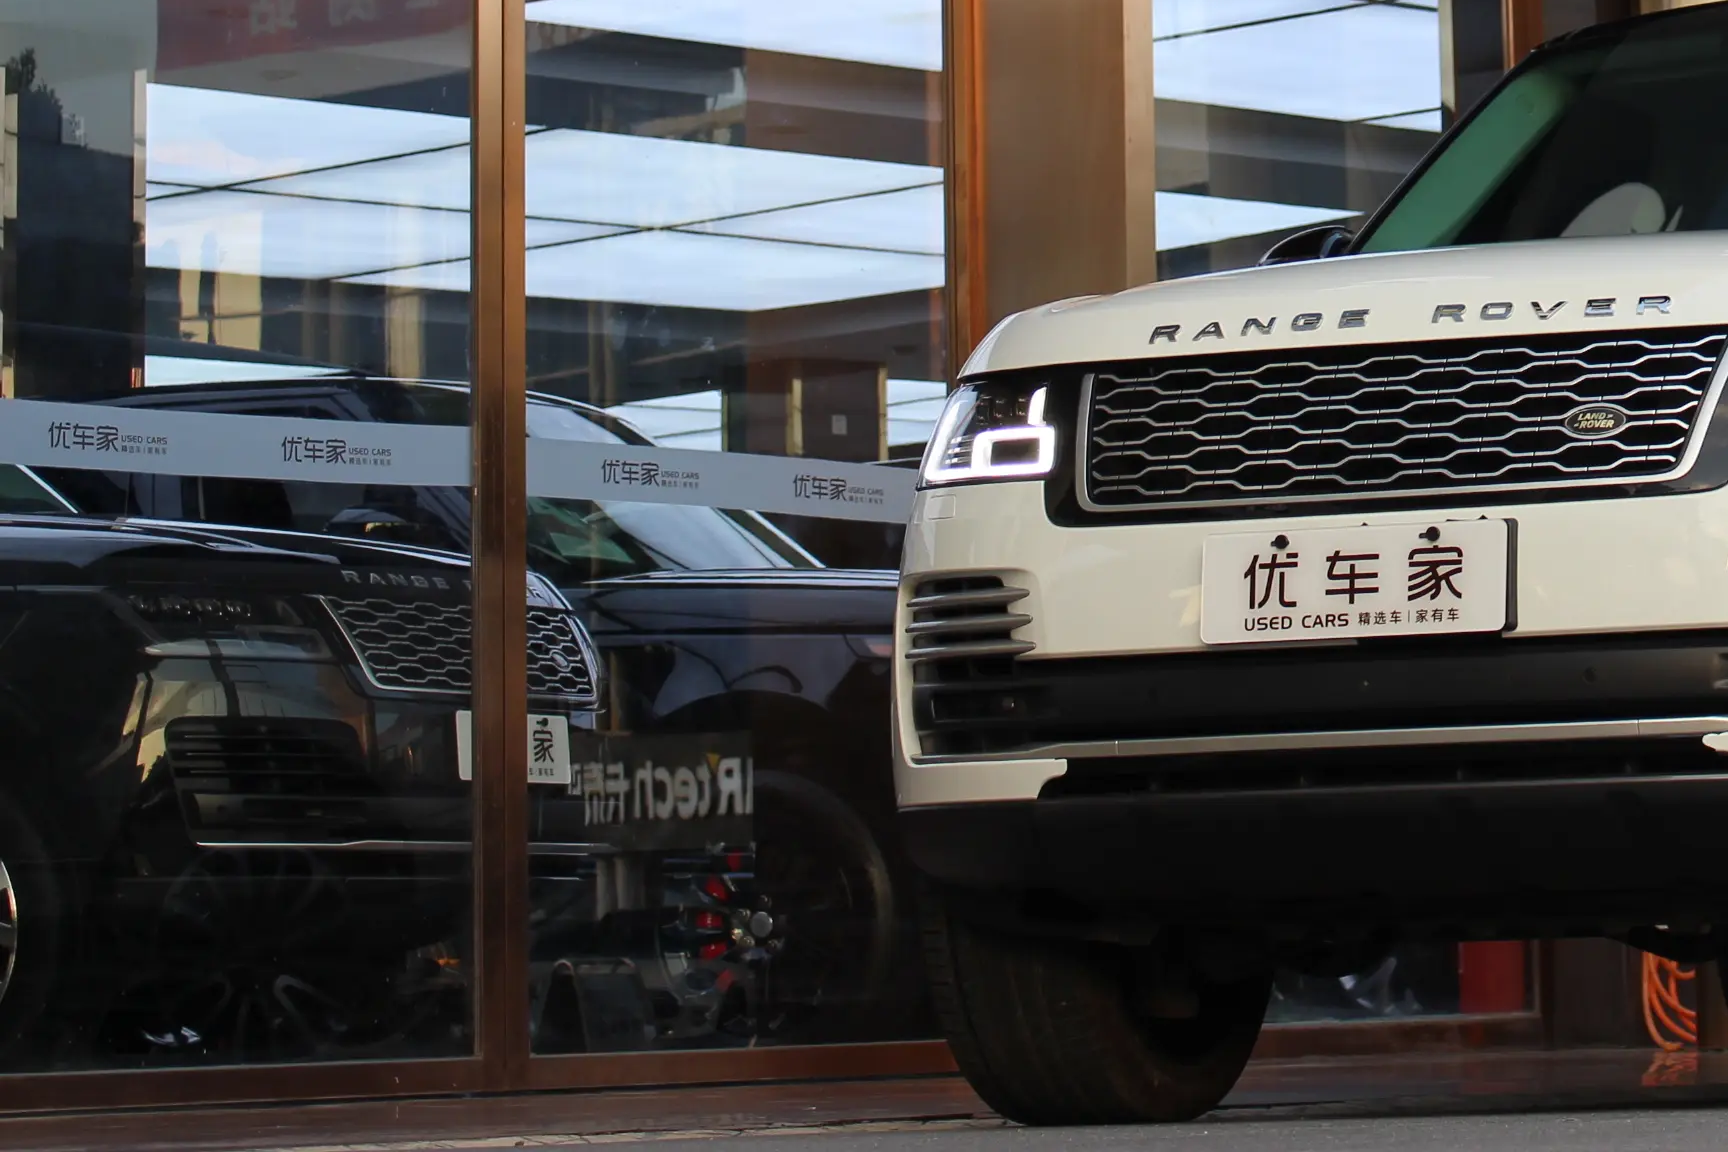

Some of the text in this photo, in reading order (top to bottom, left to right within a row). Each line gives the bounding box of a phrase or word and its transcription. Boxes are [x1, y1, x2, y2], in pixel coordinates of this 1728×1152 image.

[1148, 294, 1673, 345] RANGE ROVER
[1577, 412, 1607, 421] LAND
[1578, 419, 1615, 429] ROVER
[48, 421, 119, 452] 优车家
[121, 434, 168, 445] USED CARS
[281, 436, 347, 464] 优车家
[348, 447, 392, 457] USED CARS
[601, 459, 660, 486] 优车家
[681, 471, 700, 480] CARS
[793, 474, 847, 501] 优车家
[340, 569, 451, 591] RANGE
[1244, 545, 1463, 609] 优车家
[1244, 616, 1293, 632] USED
[1301, 613, 1349, 629] CARS
